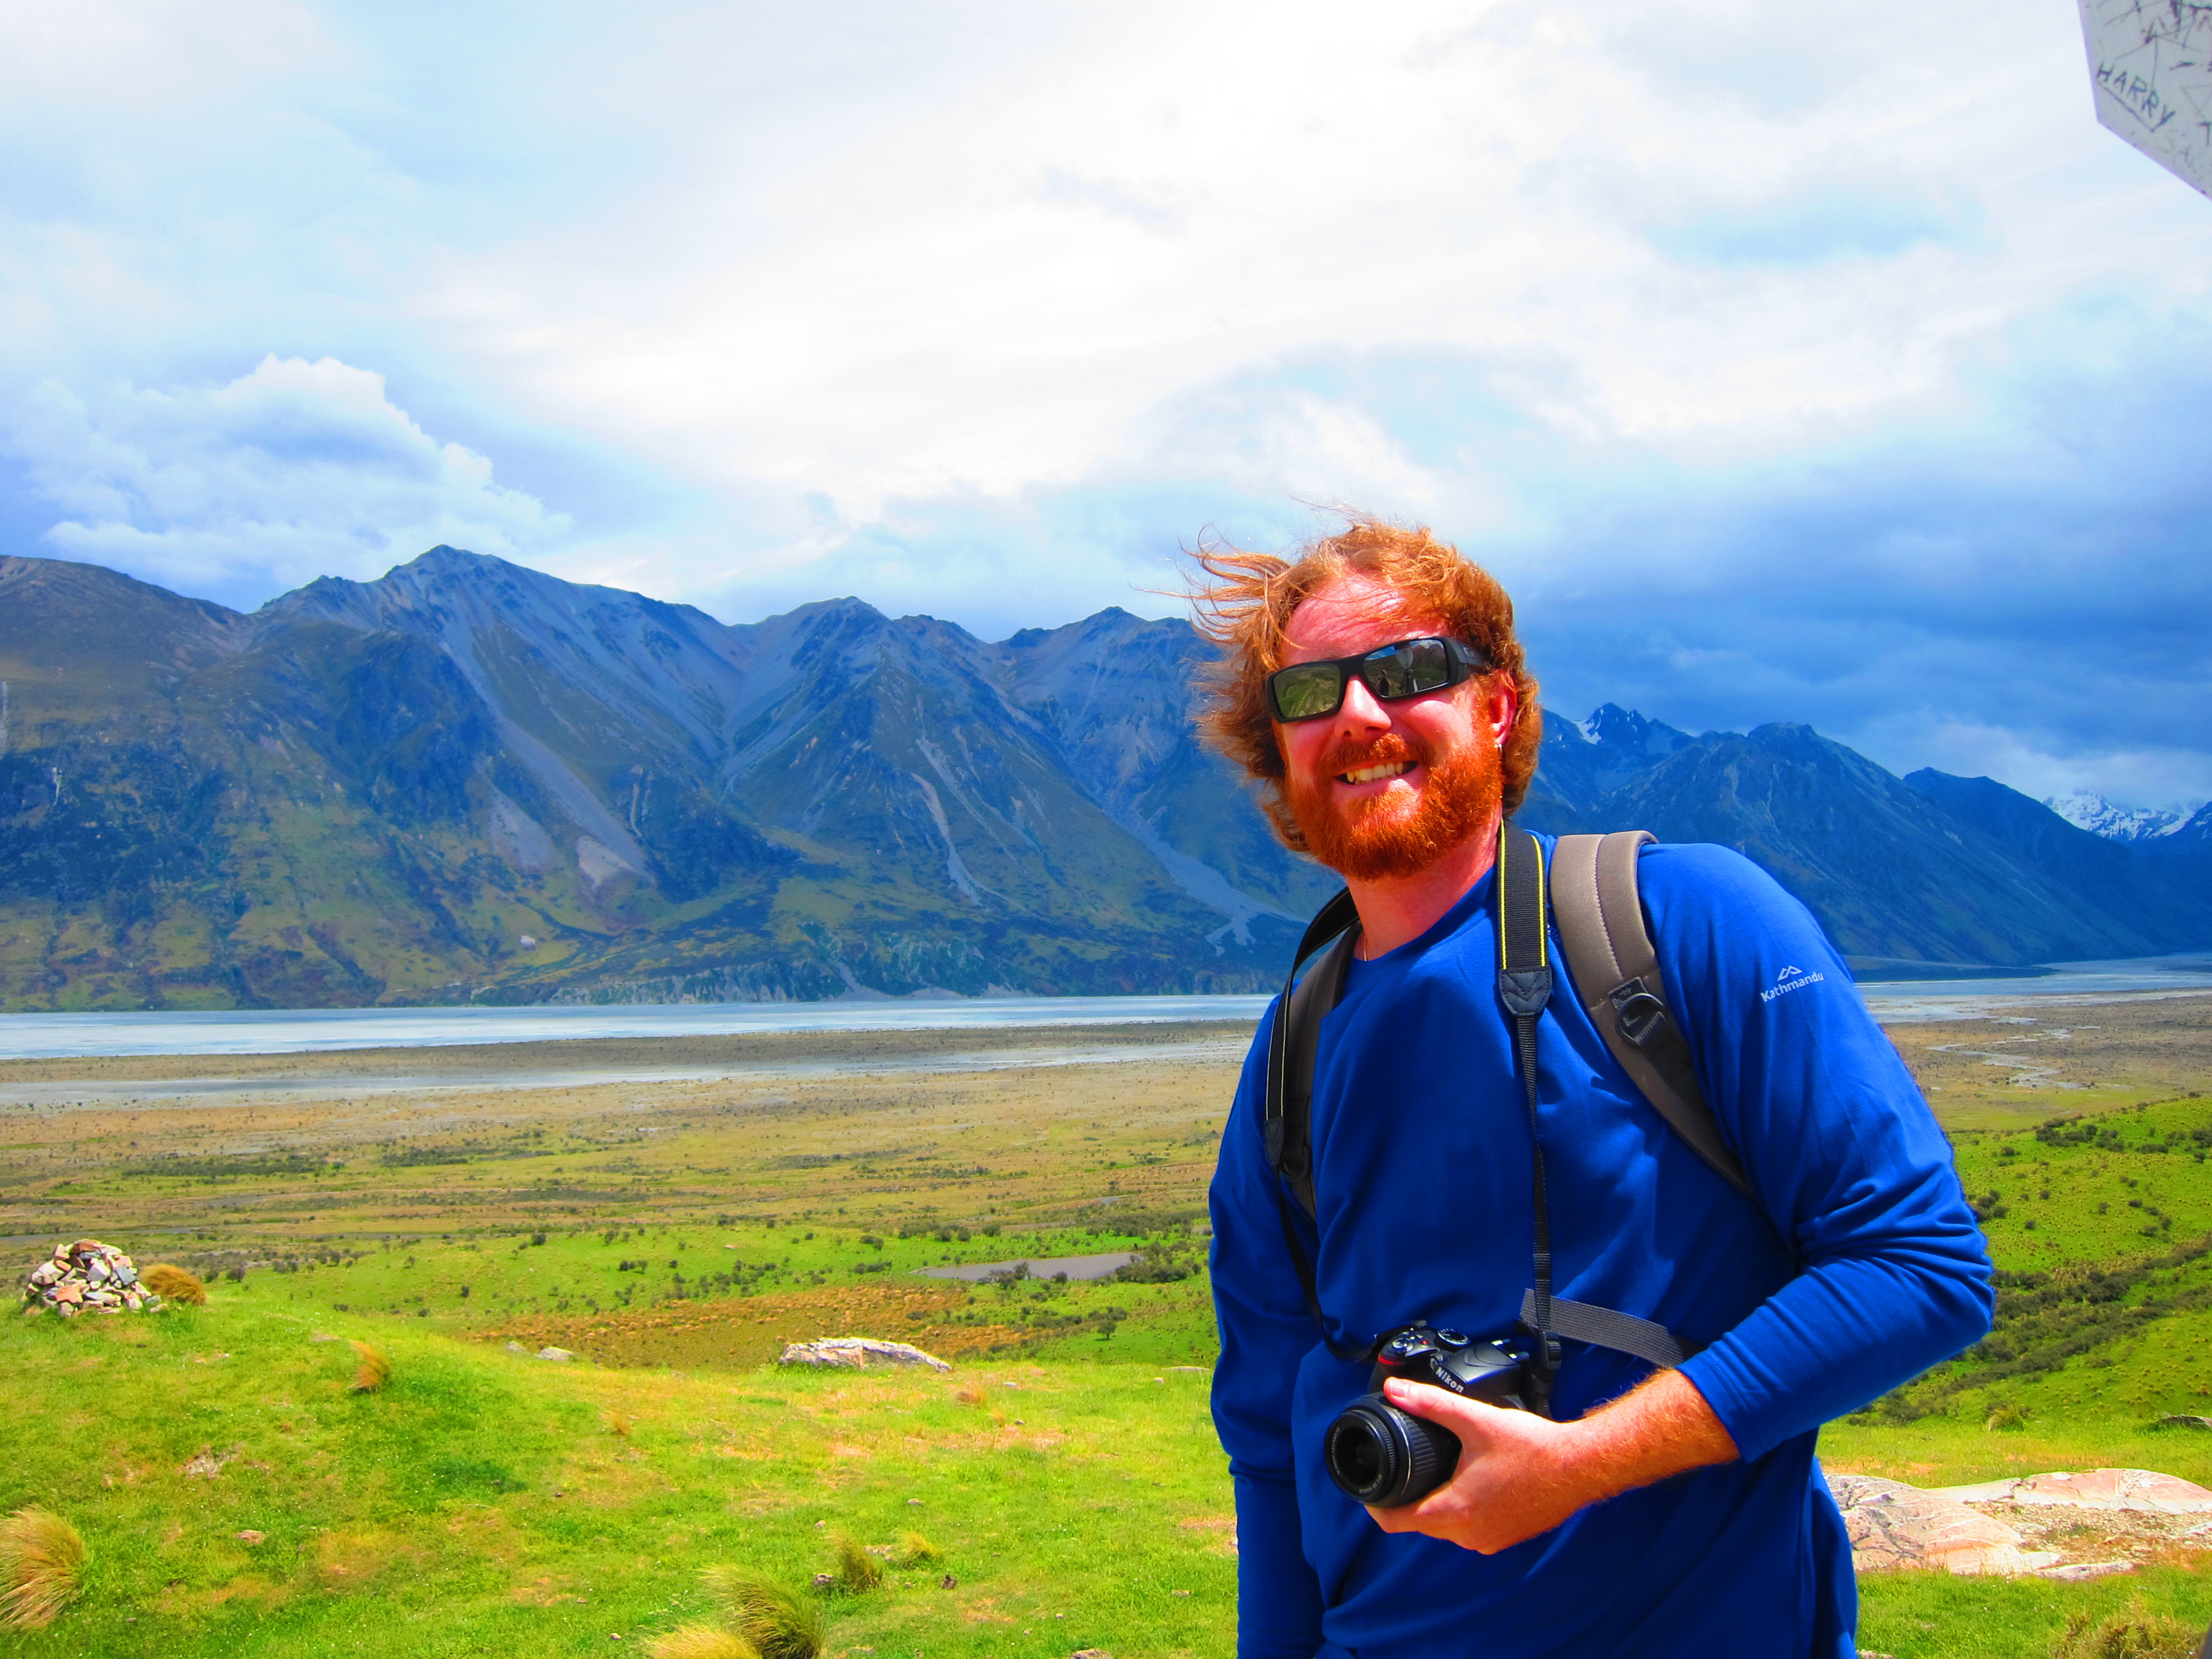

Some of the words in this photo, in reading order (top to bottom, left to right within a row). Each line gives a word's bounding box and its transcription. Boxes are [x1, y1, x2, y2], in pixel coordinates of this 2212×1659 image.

[2096, 61, 2176, 132] HARRY
[1760, 971, 1824, 1002] Kathmandu
[1435, 1366, 1464, 1393] Nikon
